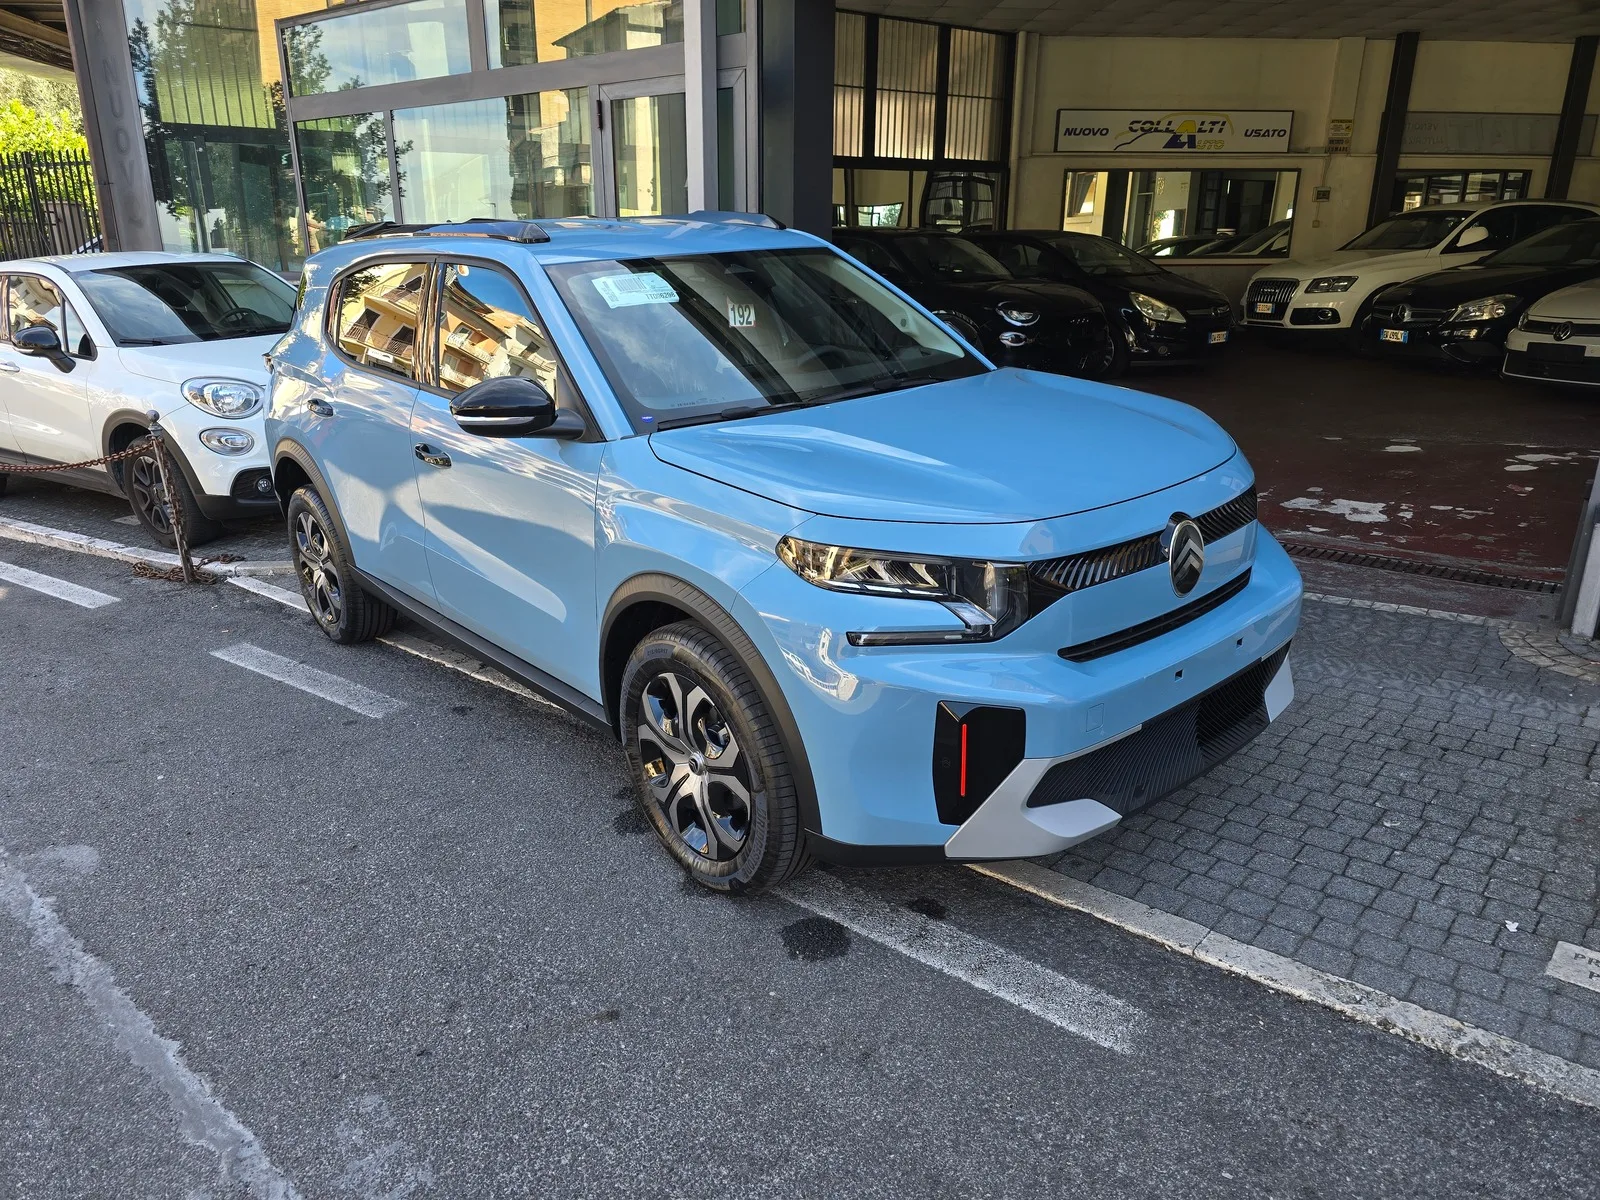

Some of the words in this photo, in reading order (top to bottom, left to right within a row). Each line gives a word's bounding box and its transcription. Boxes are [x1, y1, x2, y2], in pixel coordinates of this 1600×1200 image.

[1063, 127, 1110, 137] NUOVO
[1243, 128, 1288, 138] USATO
[730, 304, 753, 326] 192
